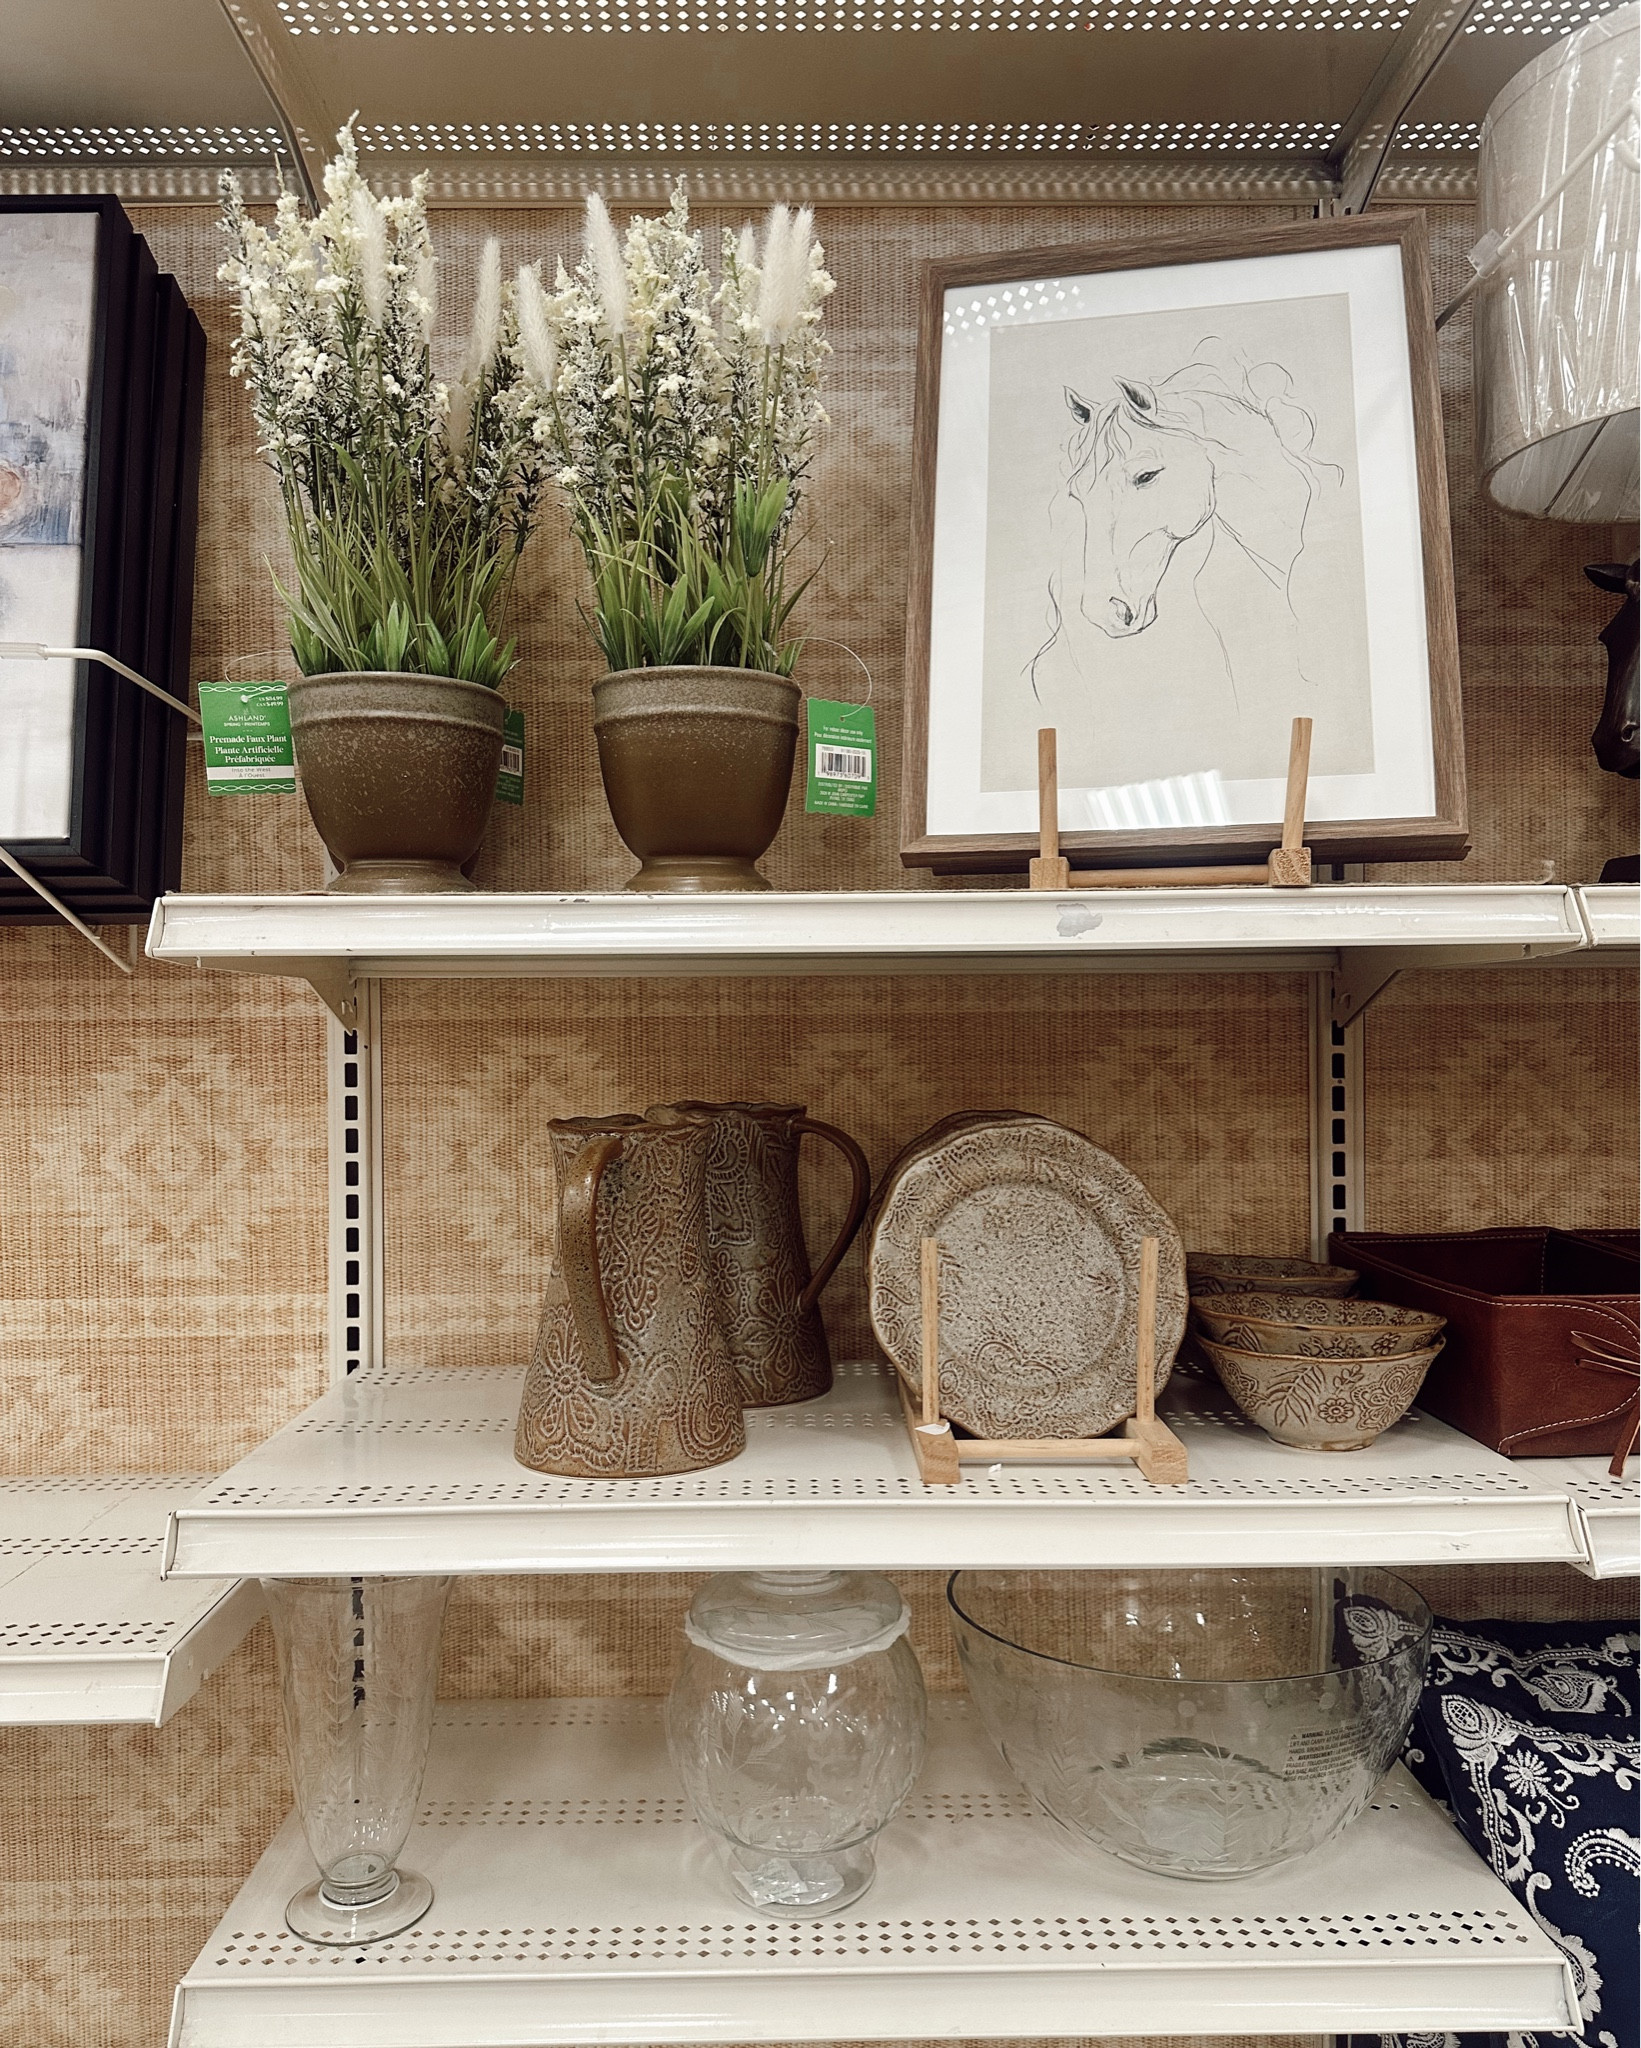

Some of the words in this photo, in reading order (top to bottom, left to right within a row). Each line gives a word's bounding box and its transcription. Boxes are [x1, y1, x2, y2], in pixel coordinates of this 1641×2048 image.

[209, 736, 246, 744] Premade
[266, 734, 287, 743] Plant
[214, 746, 240, 754] Plante
[242, 746, 284, 754] Artificielle
[224, 755, 276, 764] Préfabriquée
